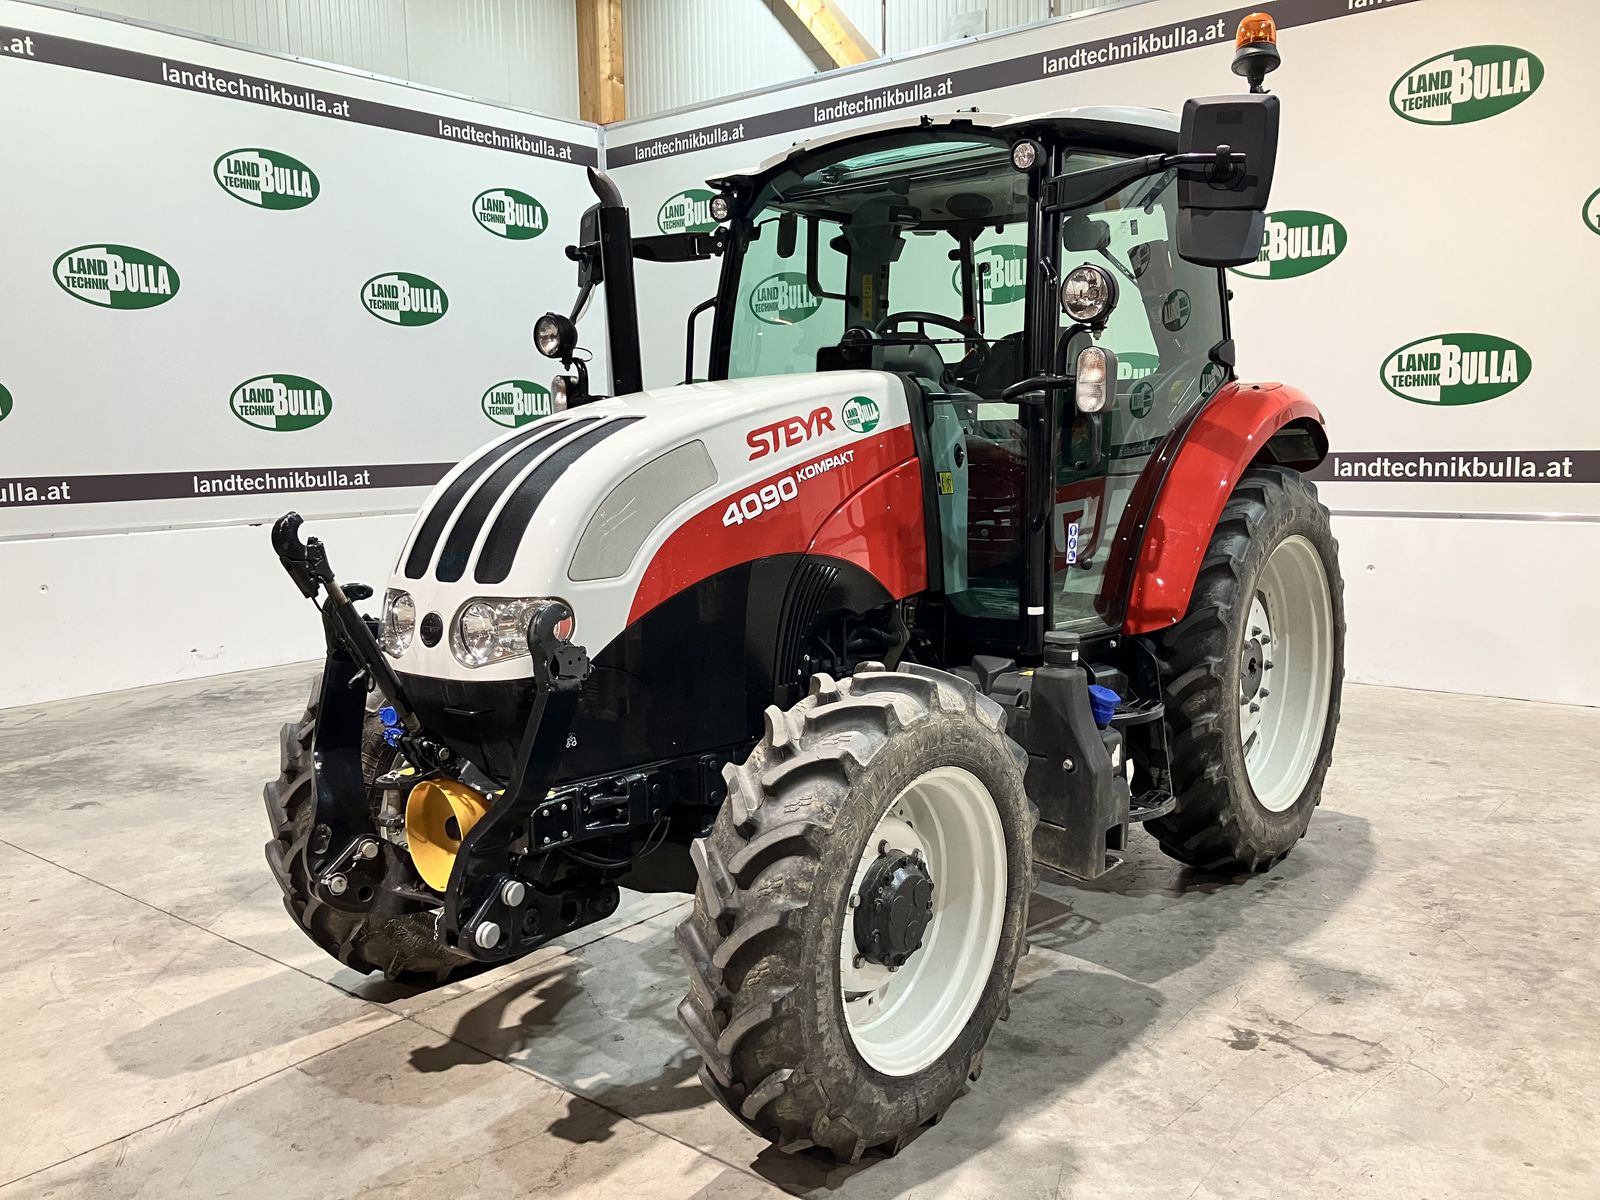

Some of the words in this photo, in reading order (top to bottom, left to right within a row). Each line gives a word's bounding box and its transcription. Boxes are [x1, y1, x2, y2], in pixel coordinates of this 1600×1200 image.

[1043, 19, 1225, 74] landtechnikbulla.at
[162, 62, 350, 117] landtechnikbulla.at
[1407, 70, 1453, 95] LAND
[1452, 57, 1531, 104] BULLA
[814, 78, 952, 122] landtechnikbulla.at
[1401, 91, 1452, 112] TECHNIK
[439, 119, 572, 160] landtechnikbulla.at
[635, 124, 744, 160] landtechnikbulla.at
[227, 158, 260, 178] LAND
[260, 157, 313, 198] BULLA
[223, 175, 261, 191] TECHNIK
[482, 197, 505, 213] LAND
[505, 196, 543, 229] BULLA
[665, 204, 685, 219] LAND
[479, 212, 506, 224] TECHNIK
[1269, 221, 1336, 261] BULLA
[68, 256, 108, 276] LAND
[107, 253, 171, 295] BULLA
[64, 275, 110, 290] TECHNIK
[371, 283, 398, 299] LAND
[368, 299, 399, 310] TECHNIK
[398, 280, 442, 313] BULLA
[757, 286, 778, 302] LAND
[1397, 352, 1441, 372] LAND
[1441, 344, 1518, 386] BULLA
[1391, 373, 1441, 387] TECHNIK
[242, 388, 274, 403] LAND
[273, 382, 325, 416] BULLA
[491, 392, 513, 404] LAND
[239, 405, 276, 416] TECHNIK
[746, 406, 836, 462] STEYR
[1334, 457, 1573, 478] landtechnikbulla.at
[193, 470, 370, 493] landtechnikbulla.at
[722, 475, 799, 528] 4090
[796, 450, 855, 483] KOMPAKT
